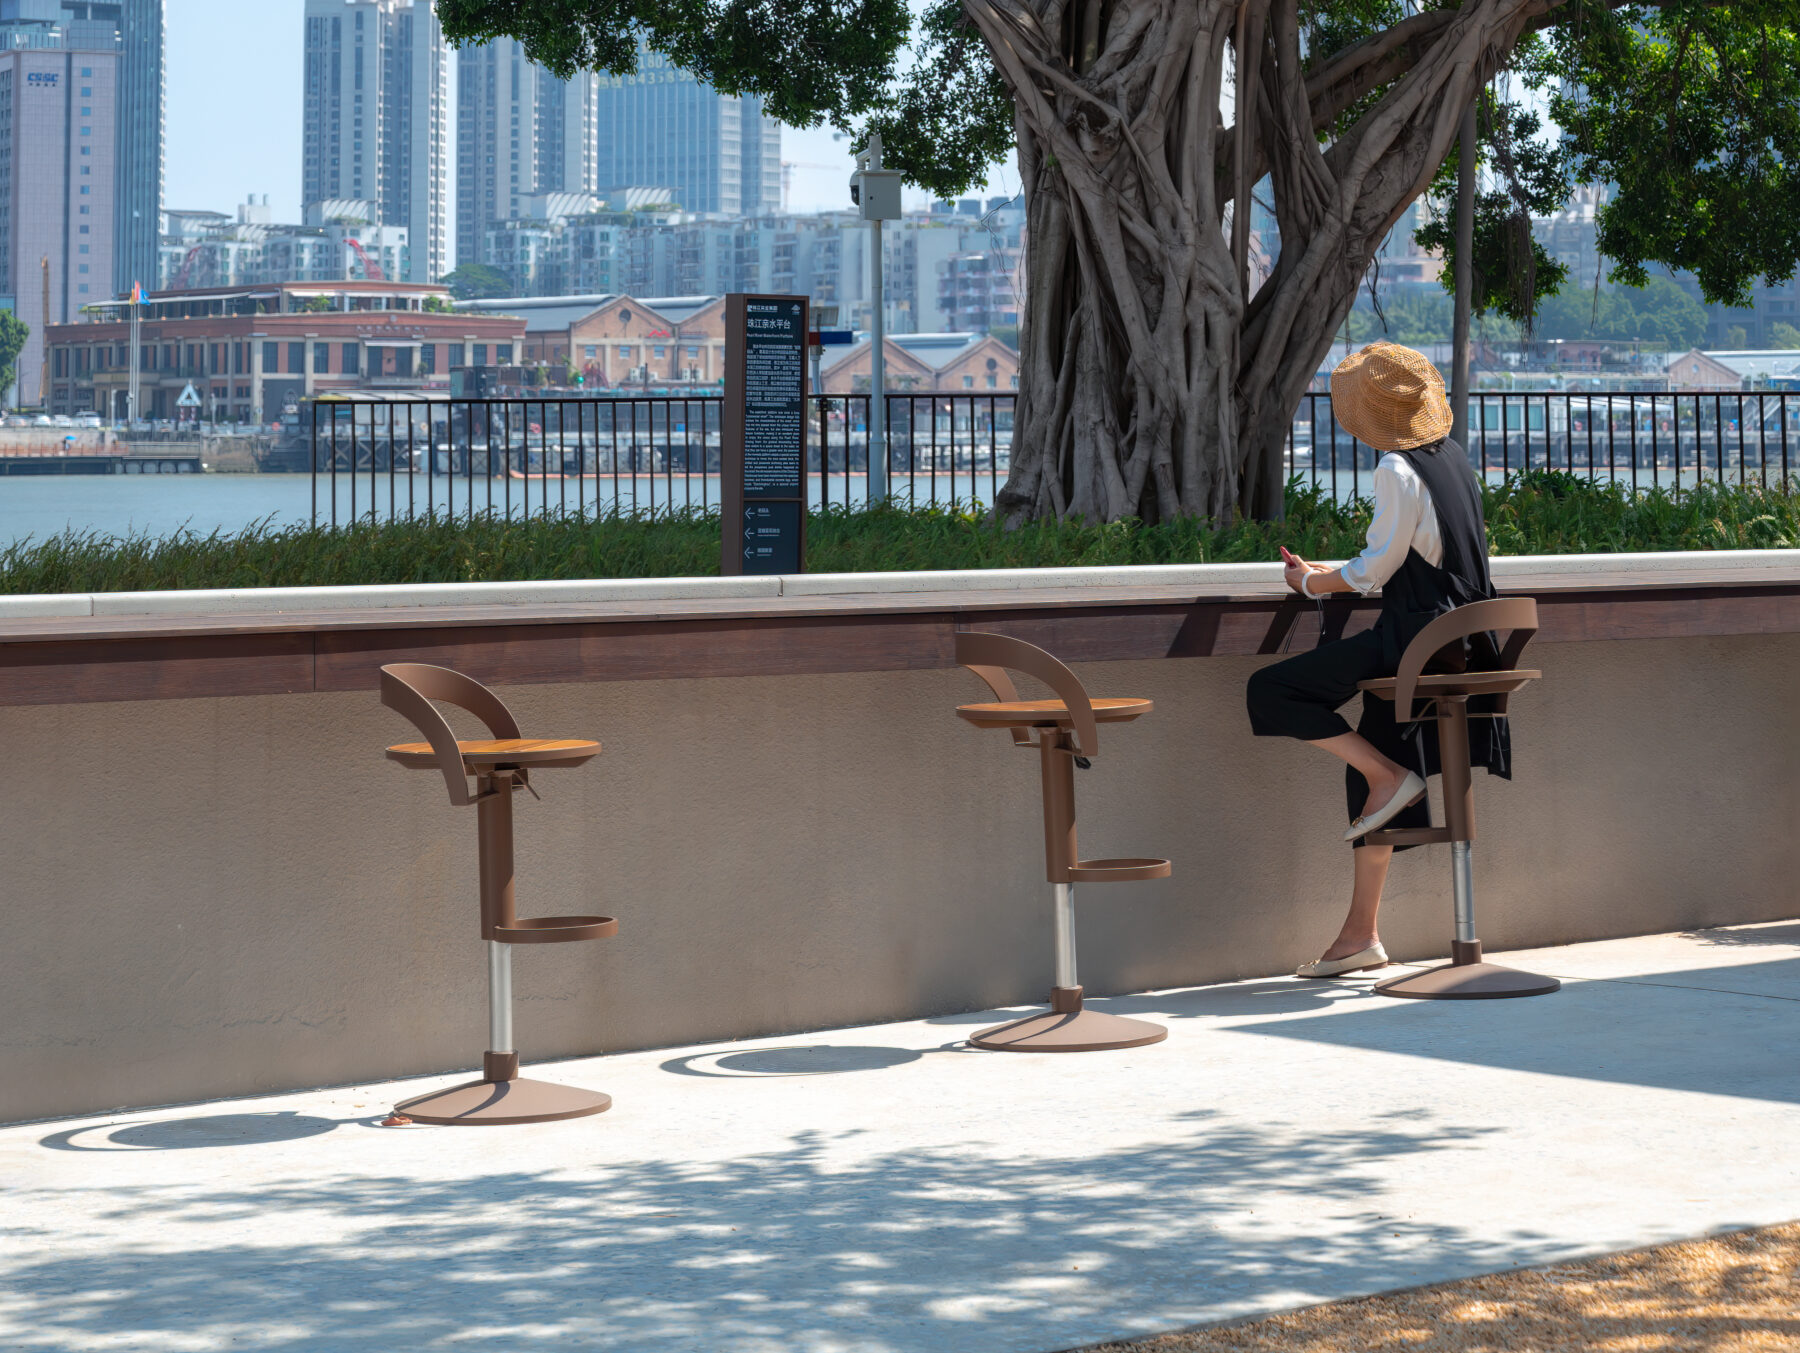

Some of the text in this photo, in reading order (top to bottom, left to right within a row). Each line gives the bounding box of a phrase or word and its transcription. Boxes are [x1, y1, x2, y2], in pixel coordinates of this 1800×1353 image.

[747, 319, 791, 329] 珠江亲水平台
